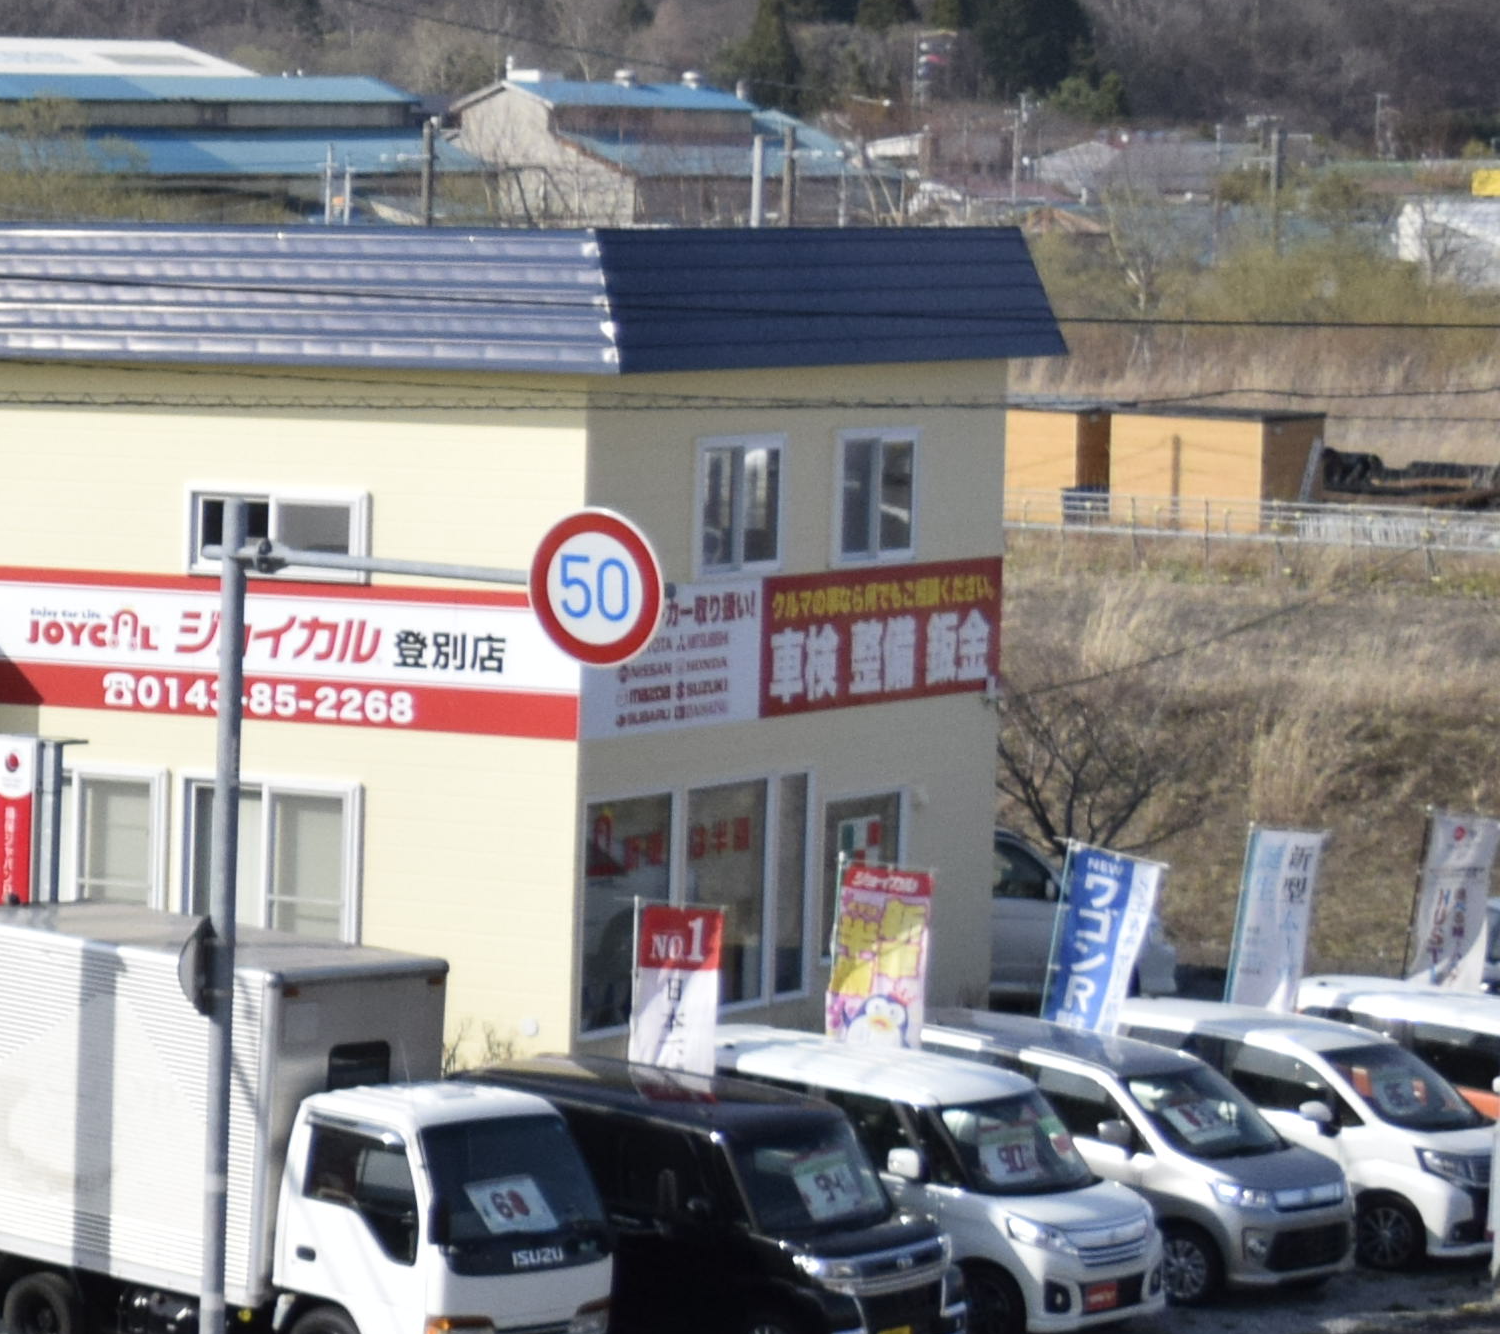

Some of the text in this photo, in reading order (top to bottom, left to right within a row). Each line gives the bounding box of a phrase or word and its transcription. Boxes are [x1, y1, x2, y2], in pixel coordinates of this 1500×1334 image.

[560, 554, 629, 621] 50
[27, 609, 158, 651] JOYCAL
[175, 610, 382, 664] ジイカル
[393, 630, 506, 673] 登別店
[1063, 873, 1121, 1013] ワゴンR
[512, 1246, 565, 1268] ISUZU
